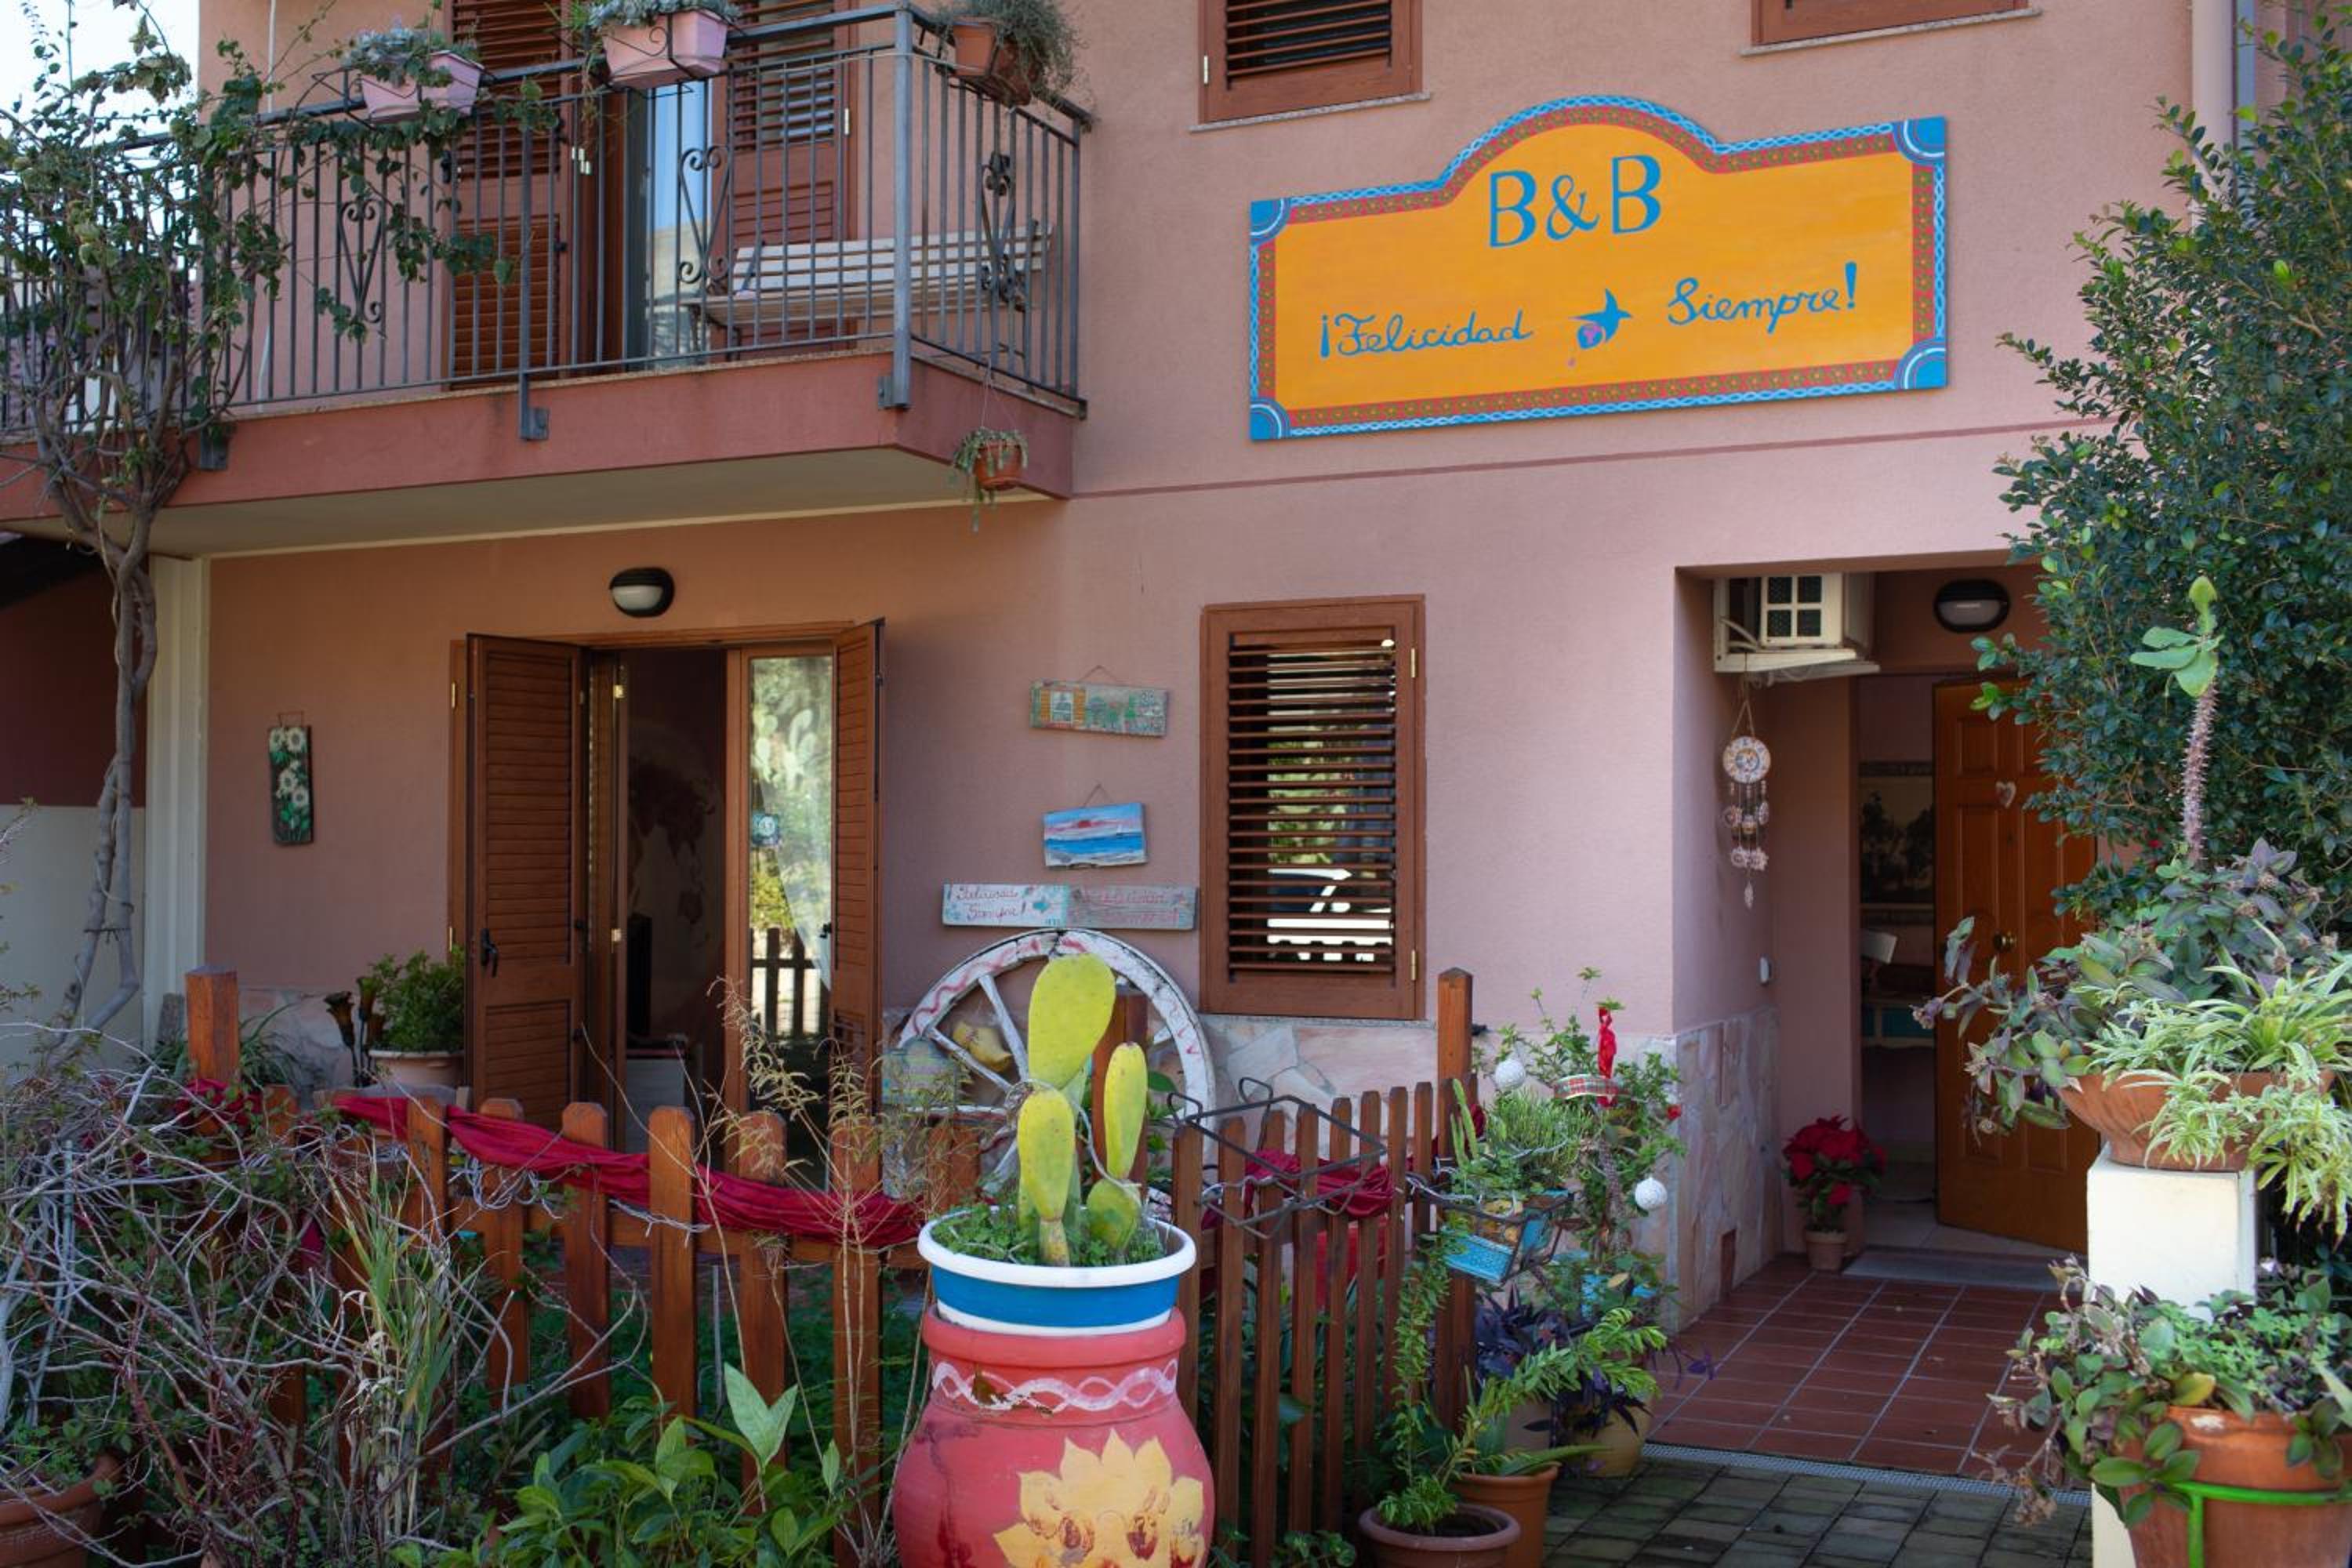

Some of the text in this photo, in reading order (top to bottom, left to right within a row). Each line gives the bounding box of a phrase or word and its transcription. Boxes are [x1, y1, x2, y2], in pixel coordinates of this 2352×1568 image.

[1489, 154, 1661, 249] B&B
[1319, 262, 1858, 358] ¡Felicidad Siempre!
